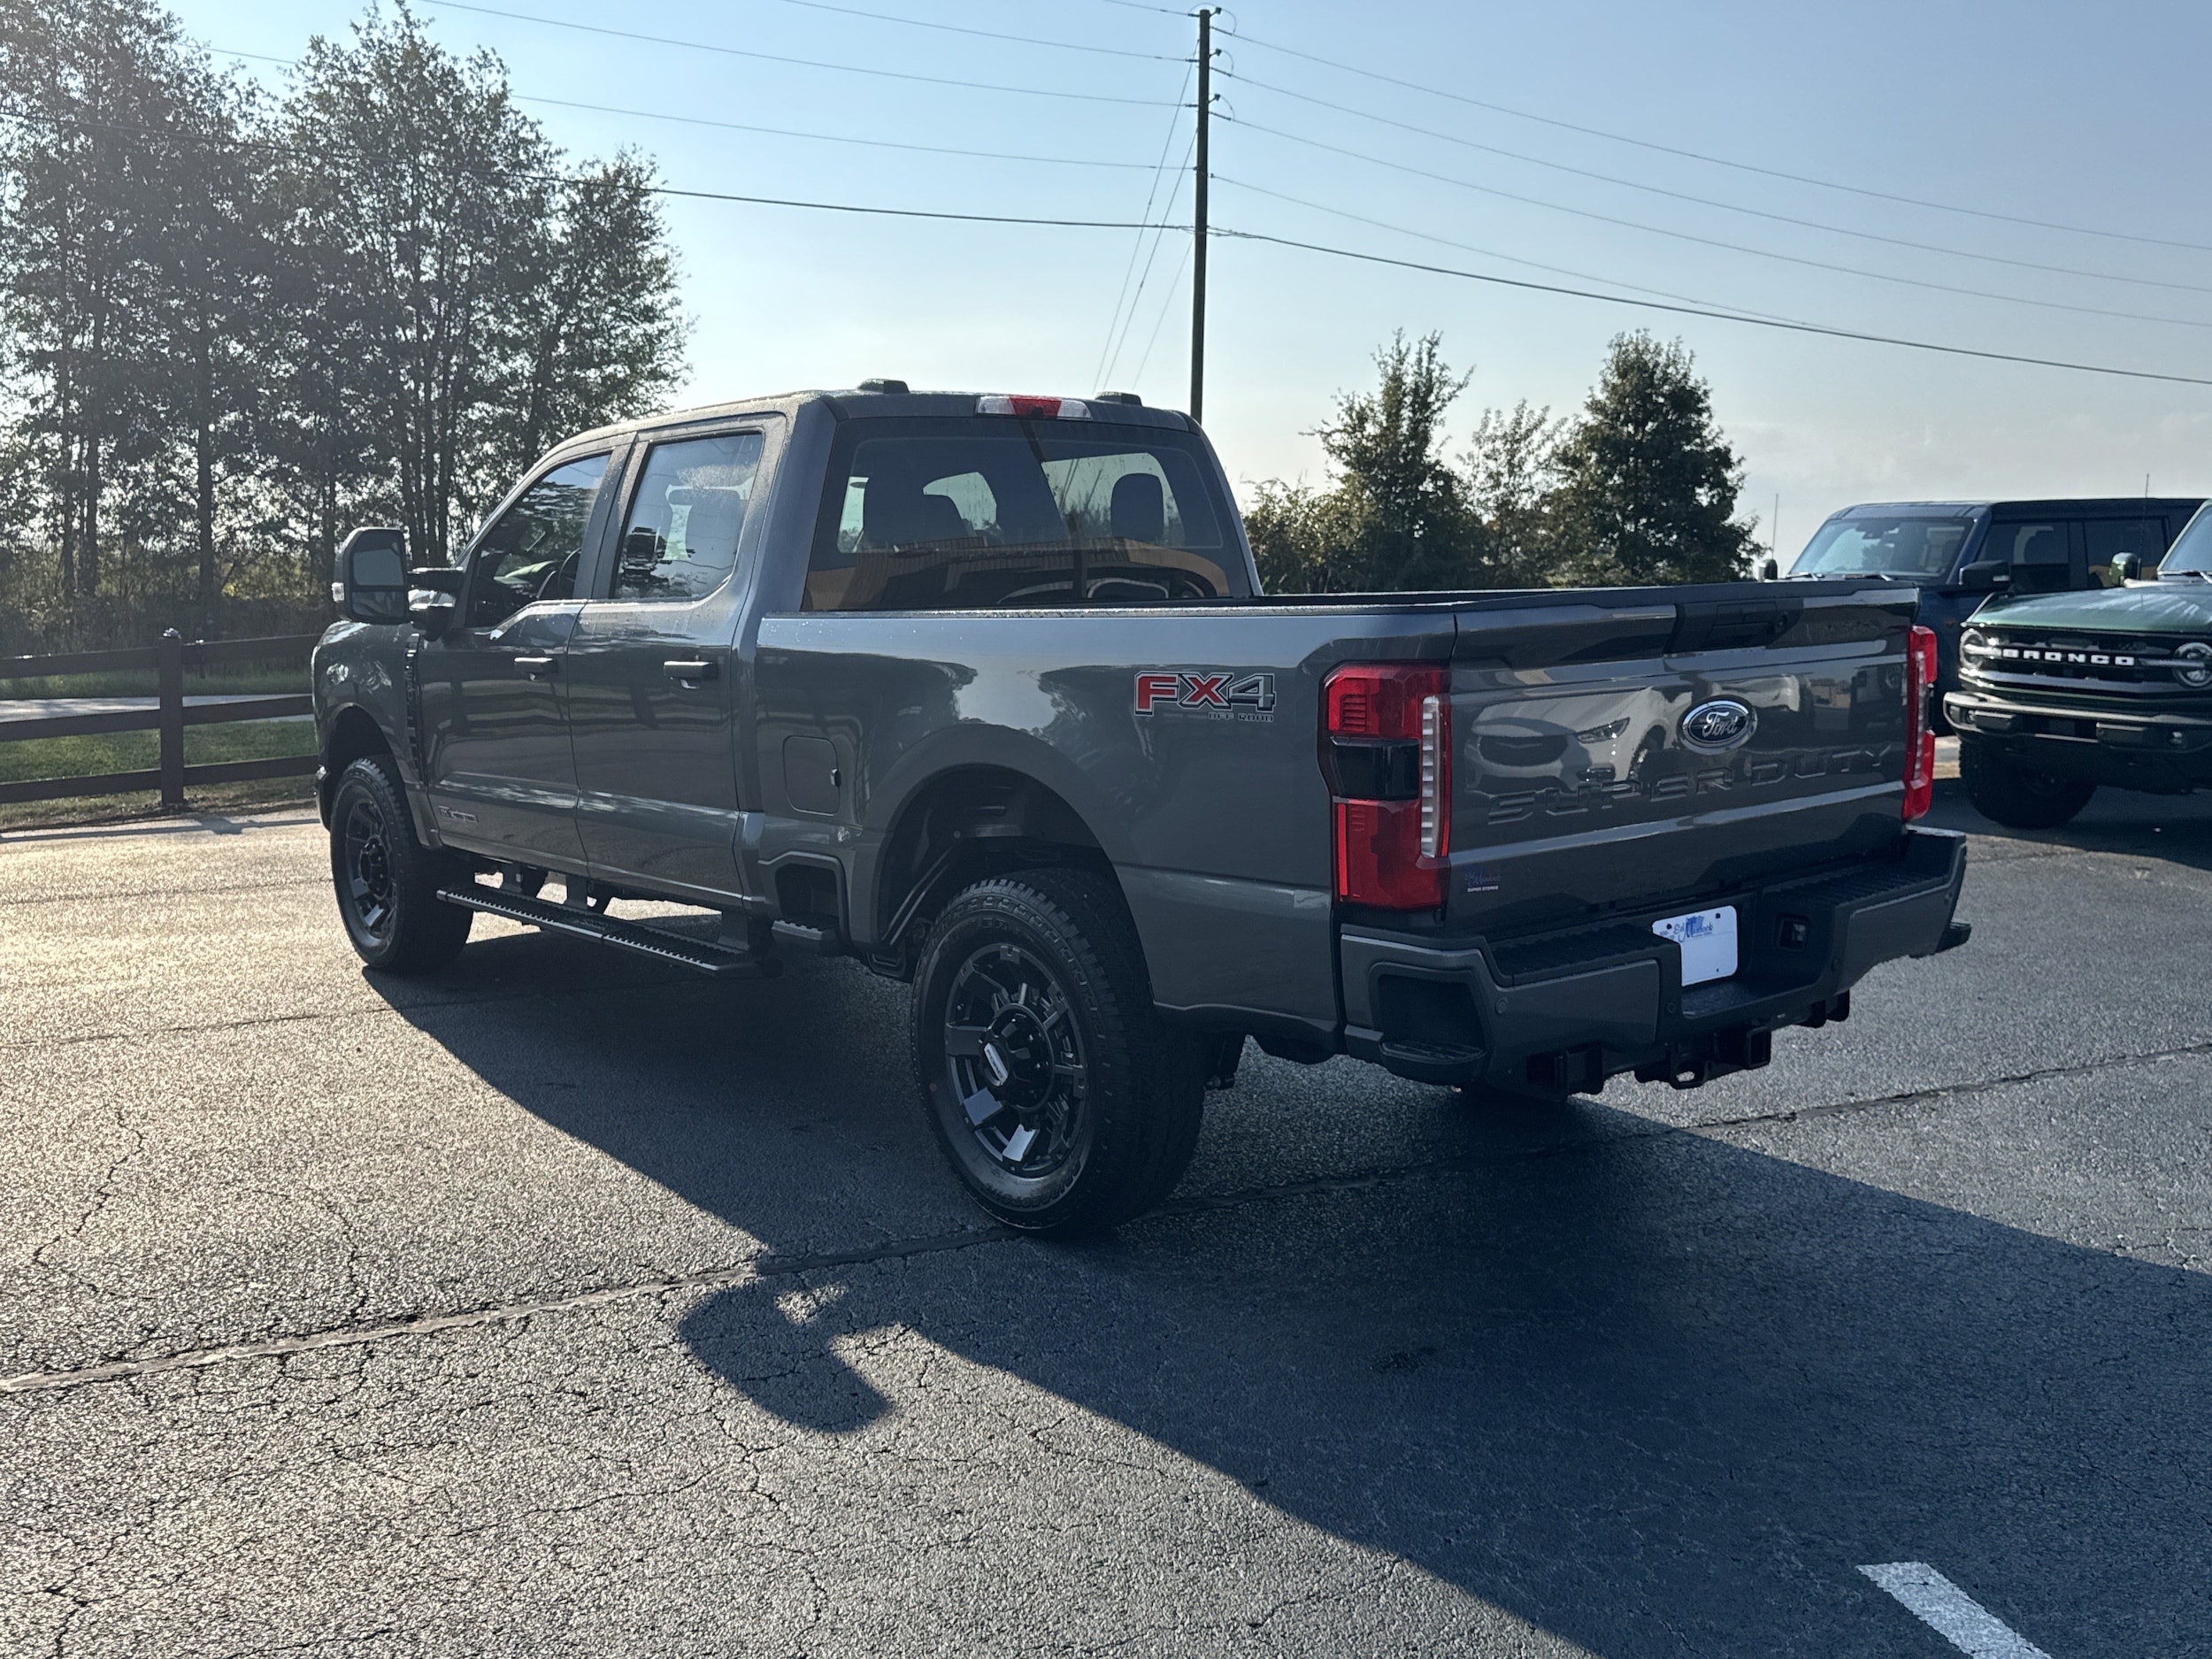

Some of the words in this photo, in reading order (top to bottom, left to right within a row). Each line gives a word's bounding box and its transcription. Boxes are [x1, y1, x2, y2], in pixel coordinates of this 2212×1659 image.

[2002, 648, 2134, 665] BRONCO
[1134, 671, 1277, 716] FX4
[1208, 711, 1234, 720] OFF
[1239, 713, 1274, 722] ROAD
[1701, 711, 1739, 738] Ford
[1488, 766, 1734, 825] SUPER
[1751, 745, 1891, 786] DUTY
